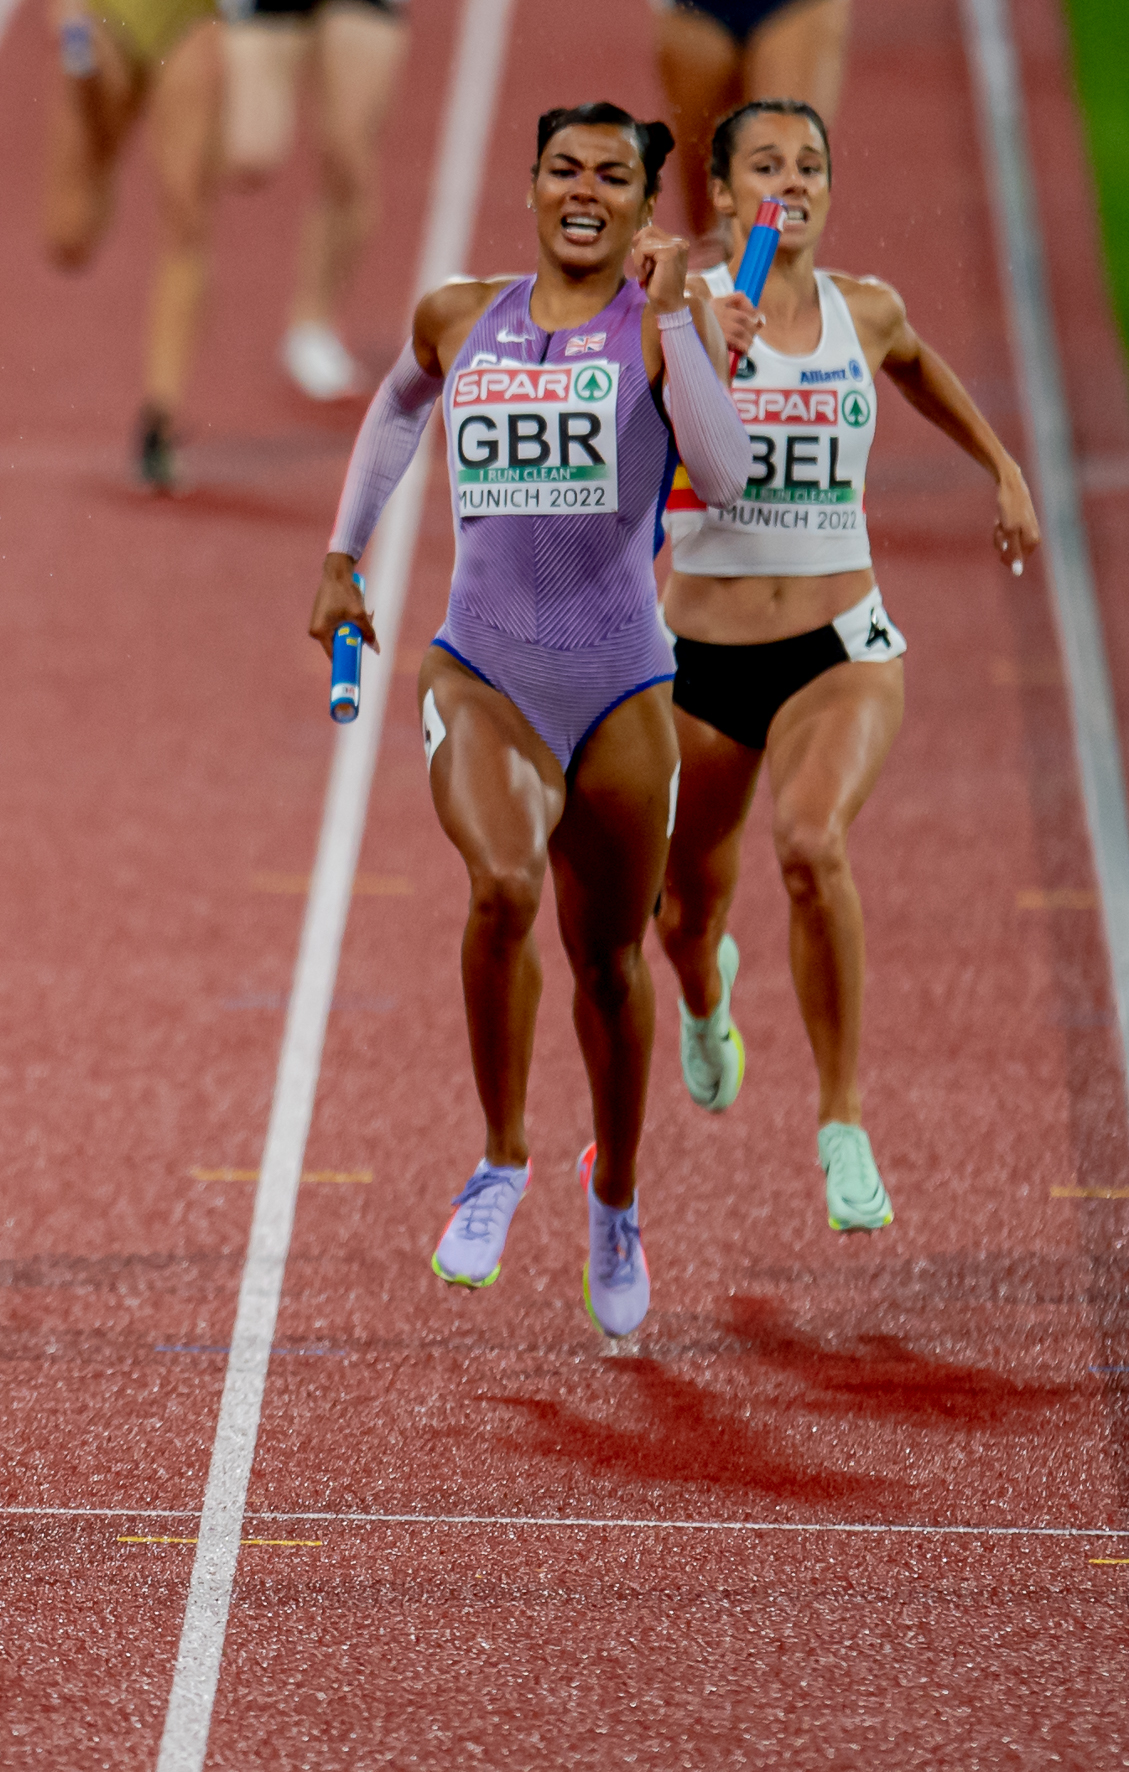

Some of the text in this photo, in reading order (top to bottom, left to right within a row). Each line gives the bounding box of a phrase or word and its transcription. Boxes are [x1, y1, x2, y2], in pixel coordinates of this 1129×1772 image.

[456, 372, 568, 403] SPAR
[800, 370, 847, 384] Allianz
[733, 392, 836, 421] SPAR
[458, 412, 606, 469] GBR
[488, 469, 520, 482] RUN
[748, 435, 852, 489] BEL
[550, 486, 605, 507] 2022
[720, 504, 857, 529] MUNICH 2022
